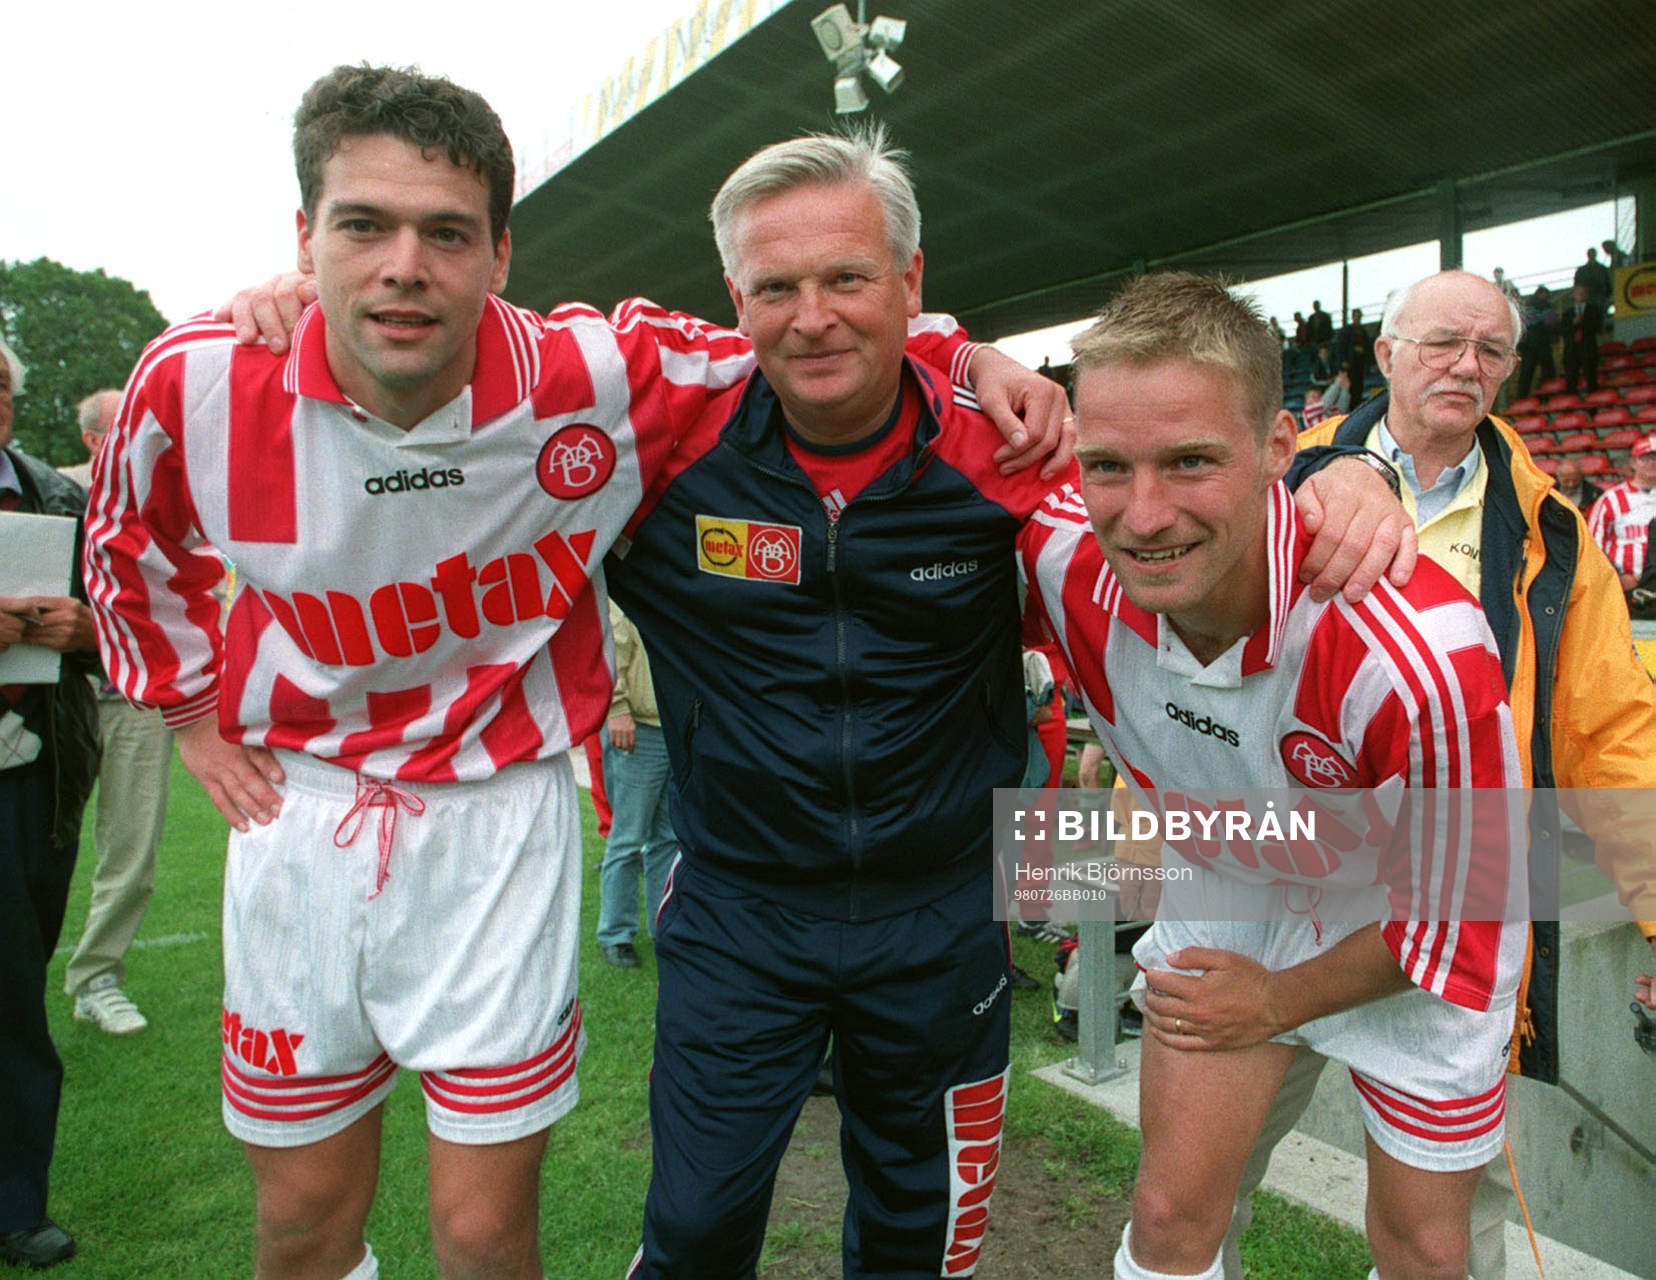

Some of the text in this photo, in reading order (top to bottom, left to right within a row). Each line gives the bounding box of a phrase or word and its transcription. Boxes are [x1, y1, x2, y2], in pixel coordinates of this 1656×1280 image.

[364, 467, 465, 495] adidas
[704, 540, 744, 558] metax
[909, 559, 979, 582] adidas
[261, 528, 597, 667] metax
[1165, 701, 1240, 748] adidas
